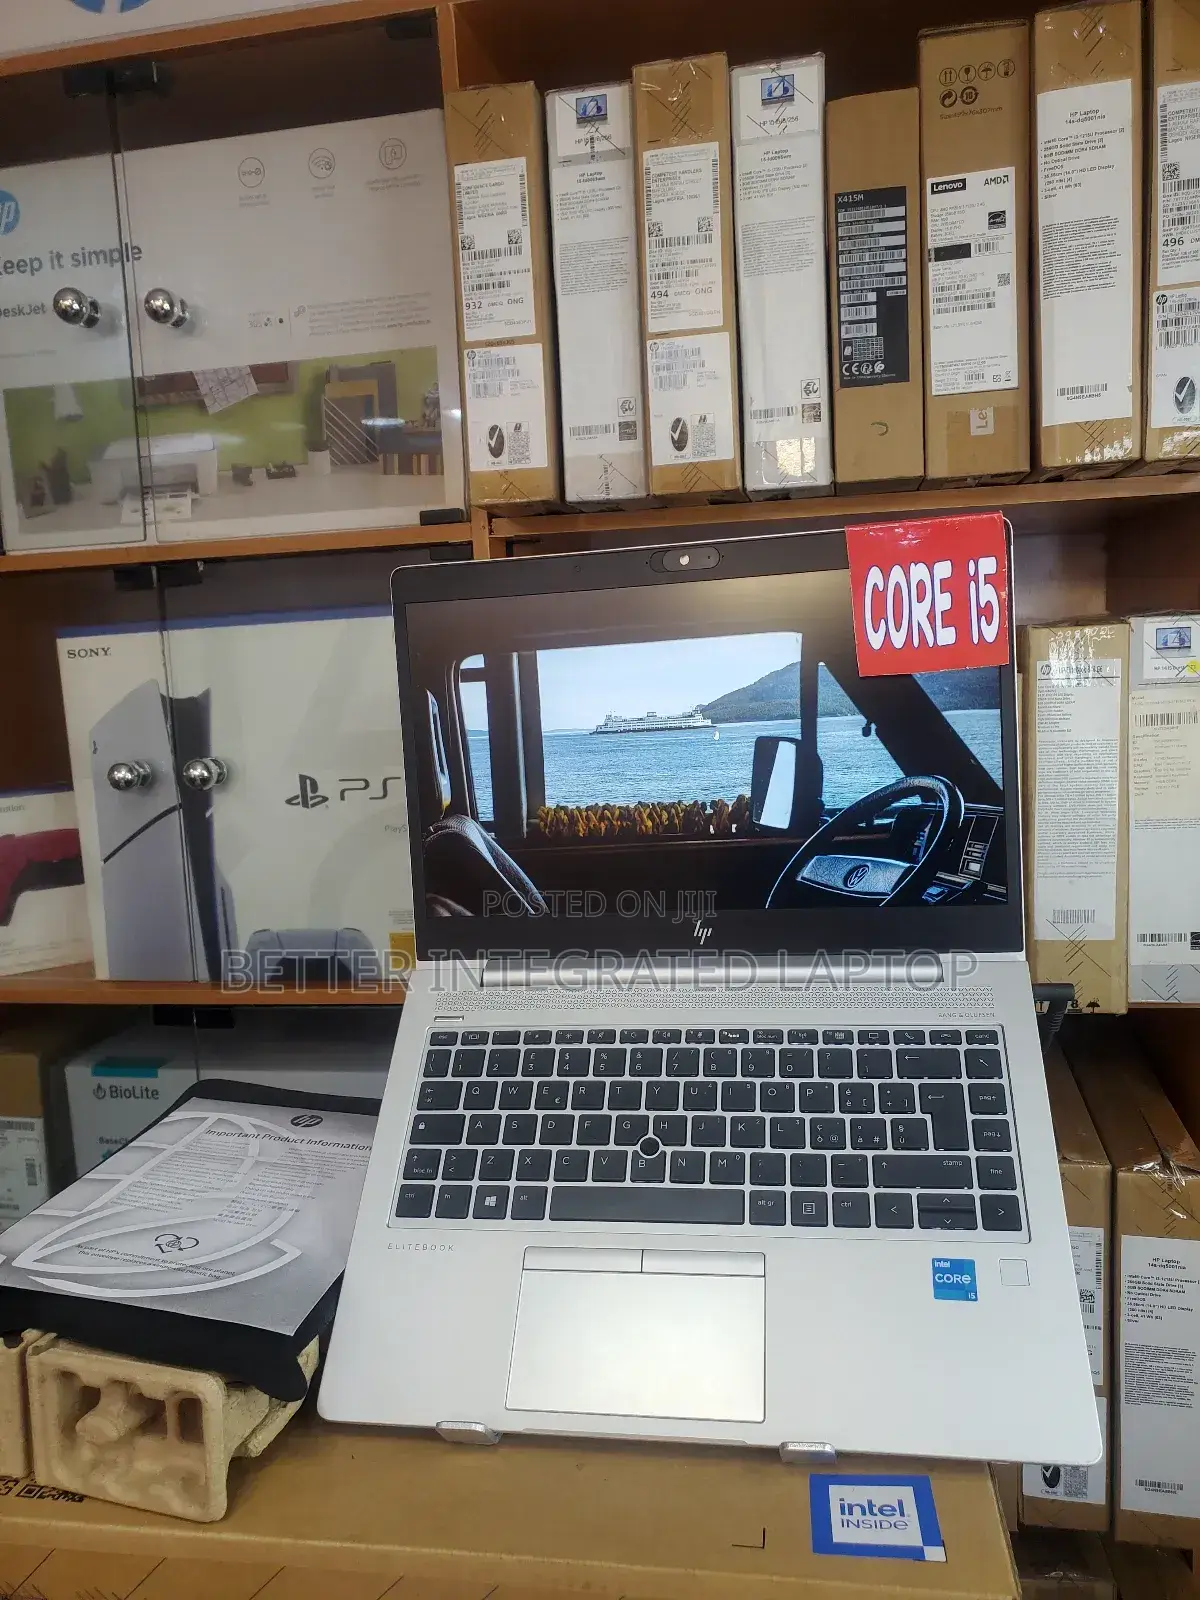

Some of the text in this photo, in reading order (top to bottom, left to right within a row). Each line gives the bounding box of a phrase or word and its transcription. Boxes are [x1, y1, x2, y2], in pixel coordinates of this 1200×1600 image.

[933, 180, 964, 193] Lenovo
[984, 176, 1002, 186] AMD
[838, 194, 864, 204] X415M
[1162, 236, 1184, 248] 496
[0, 242, 142, 277] eep it simple
[650, 290, 669, 300] 494
[694, 286, 713, 295] ONG
[465, 301, 482, 310] 932
[864, 556, 1000, 651] CORE i5
[67, 646, 111, 660] SONY
[694, 920, 712, 945] hp
[110, 1086, 160, 1100] BioLite
[472, 1087, 480, 1095] Q
[206, 1129, 372, 1152] Important Product Information
[678, 1158, 685, 1166] N
[387, 1242, 454, 1252] ELITEBOOK
[934, 1260, 950, 1268] intel
[838, 1498, 906, 1518] intel
